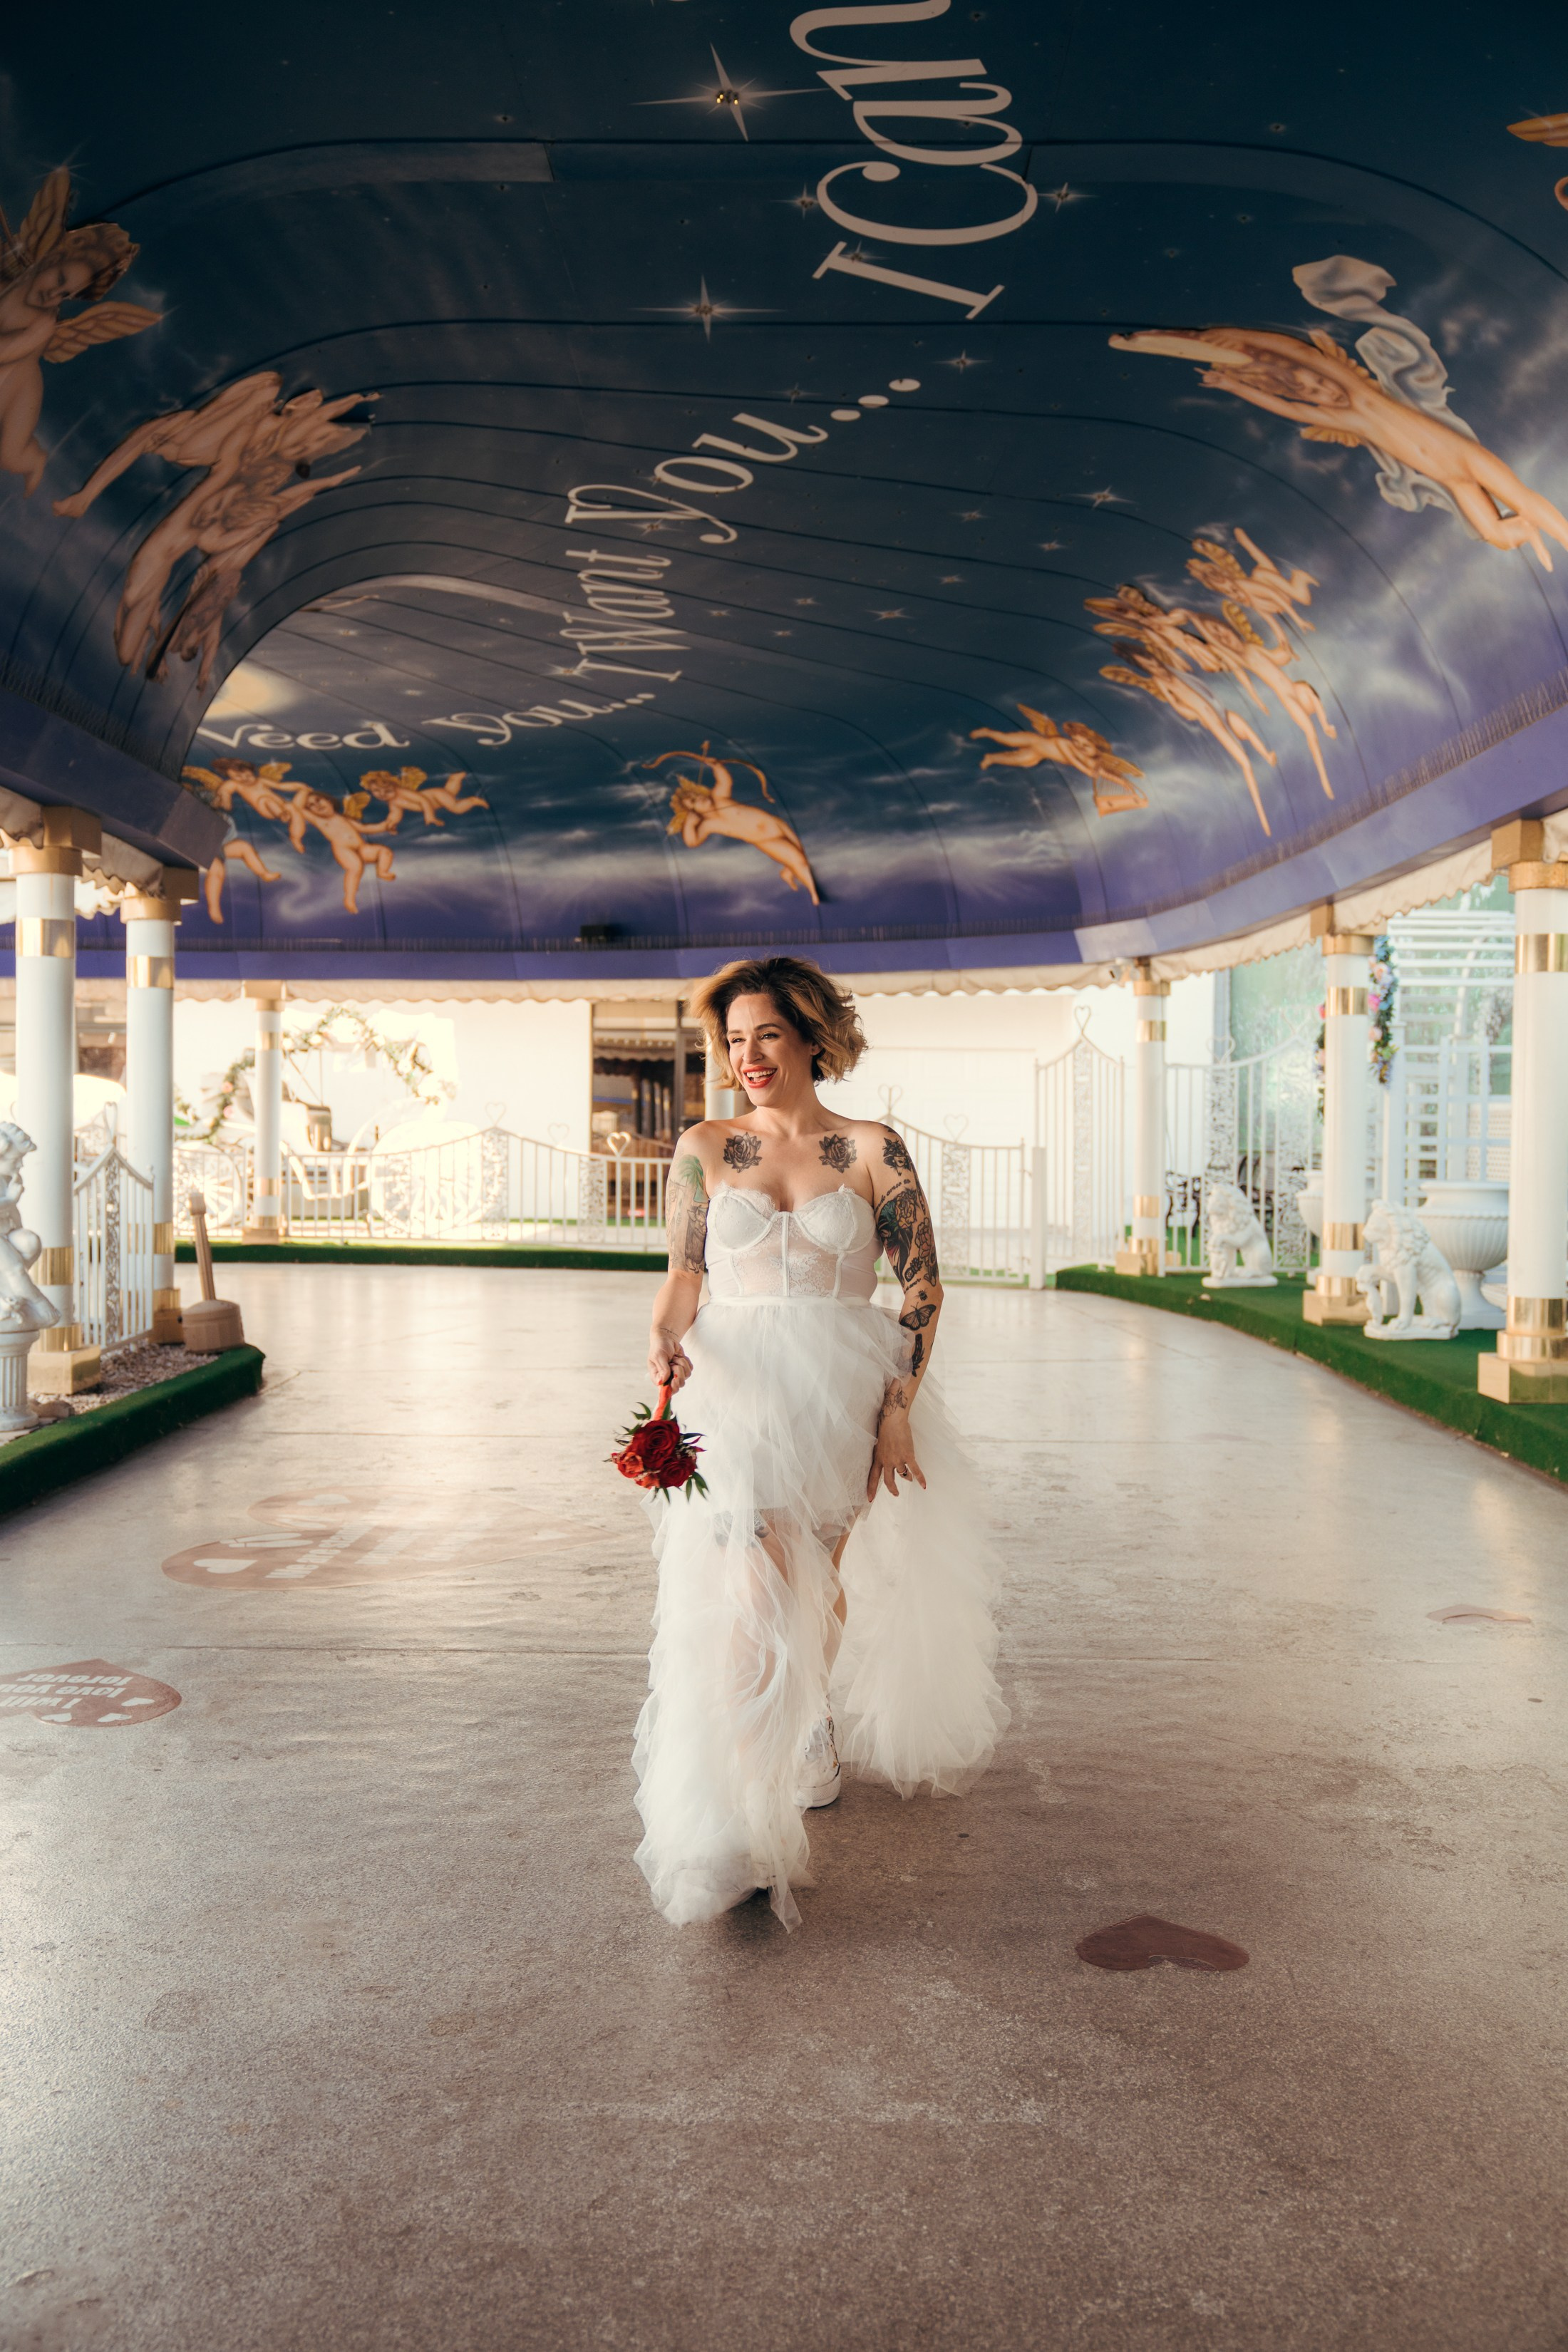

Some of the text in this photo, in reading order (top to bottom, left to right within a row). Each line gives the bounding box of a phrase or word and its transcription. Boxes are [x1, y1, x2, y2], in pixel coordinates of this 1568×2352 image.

[559, 550, 691, 655] Want
[16, 1673, 133, 1686] forever
[0, 1684, 126, 1698] love you
[0, 1696, 83, 1709] I will
